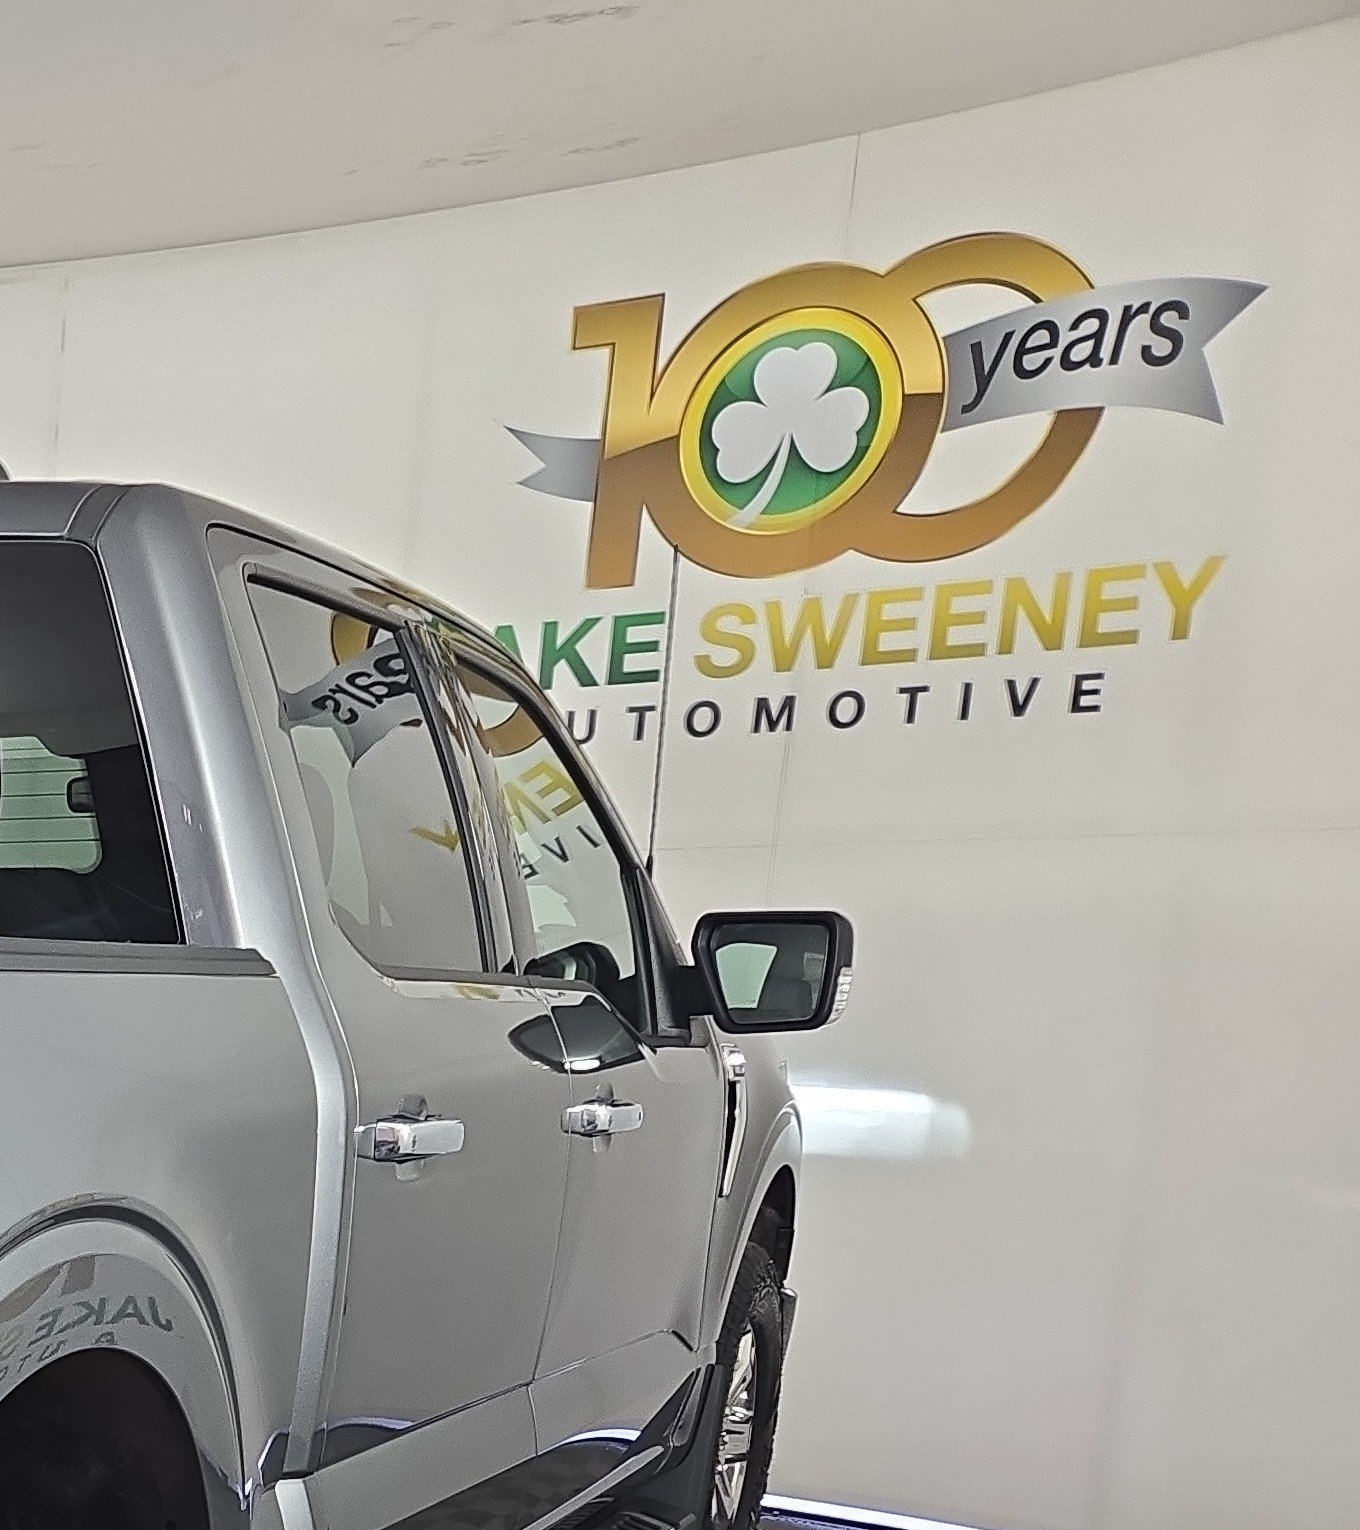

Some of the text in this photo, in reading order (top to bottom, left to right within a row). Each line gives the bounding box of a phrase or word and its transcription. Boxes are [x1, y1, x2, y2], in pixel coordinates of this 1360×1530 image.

[960, 294, 1191, 415] years
[691, 554, 1228, 681] SWEENEY
[566, 670, 1107, 746] UTOMOTIVE
